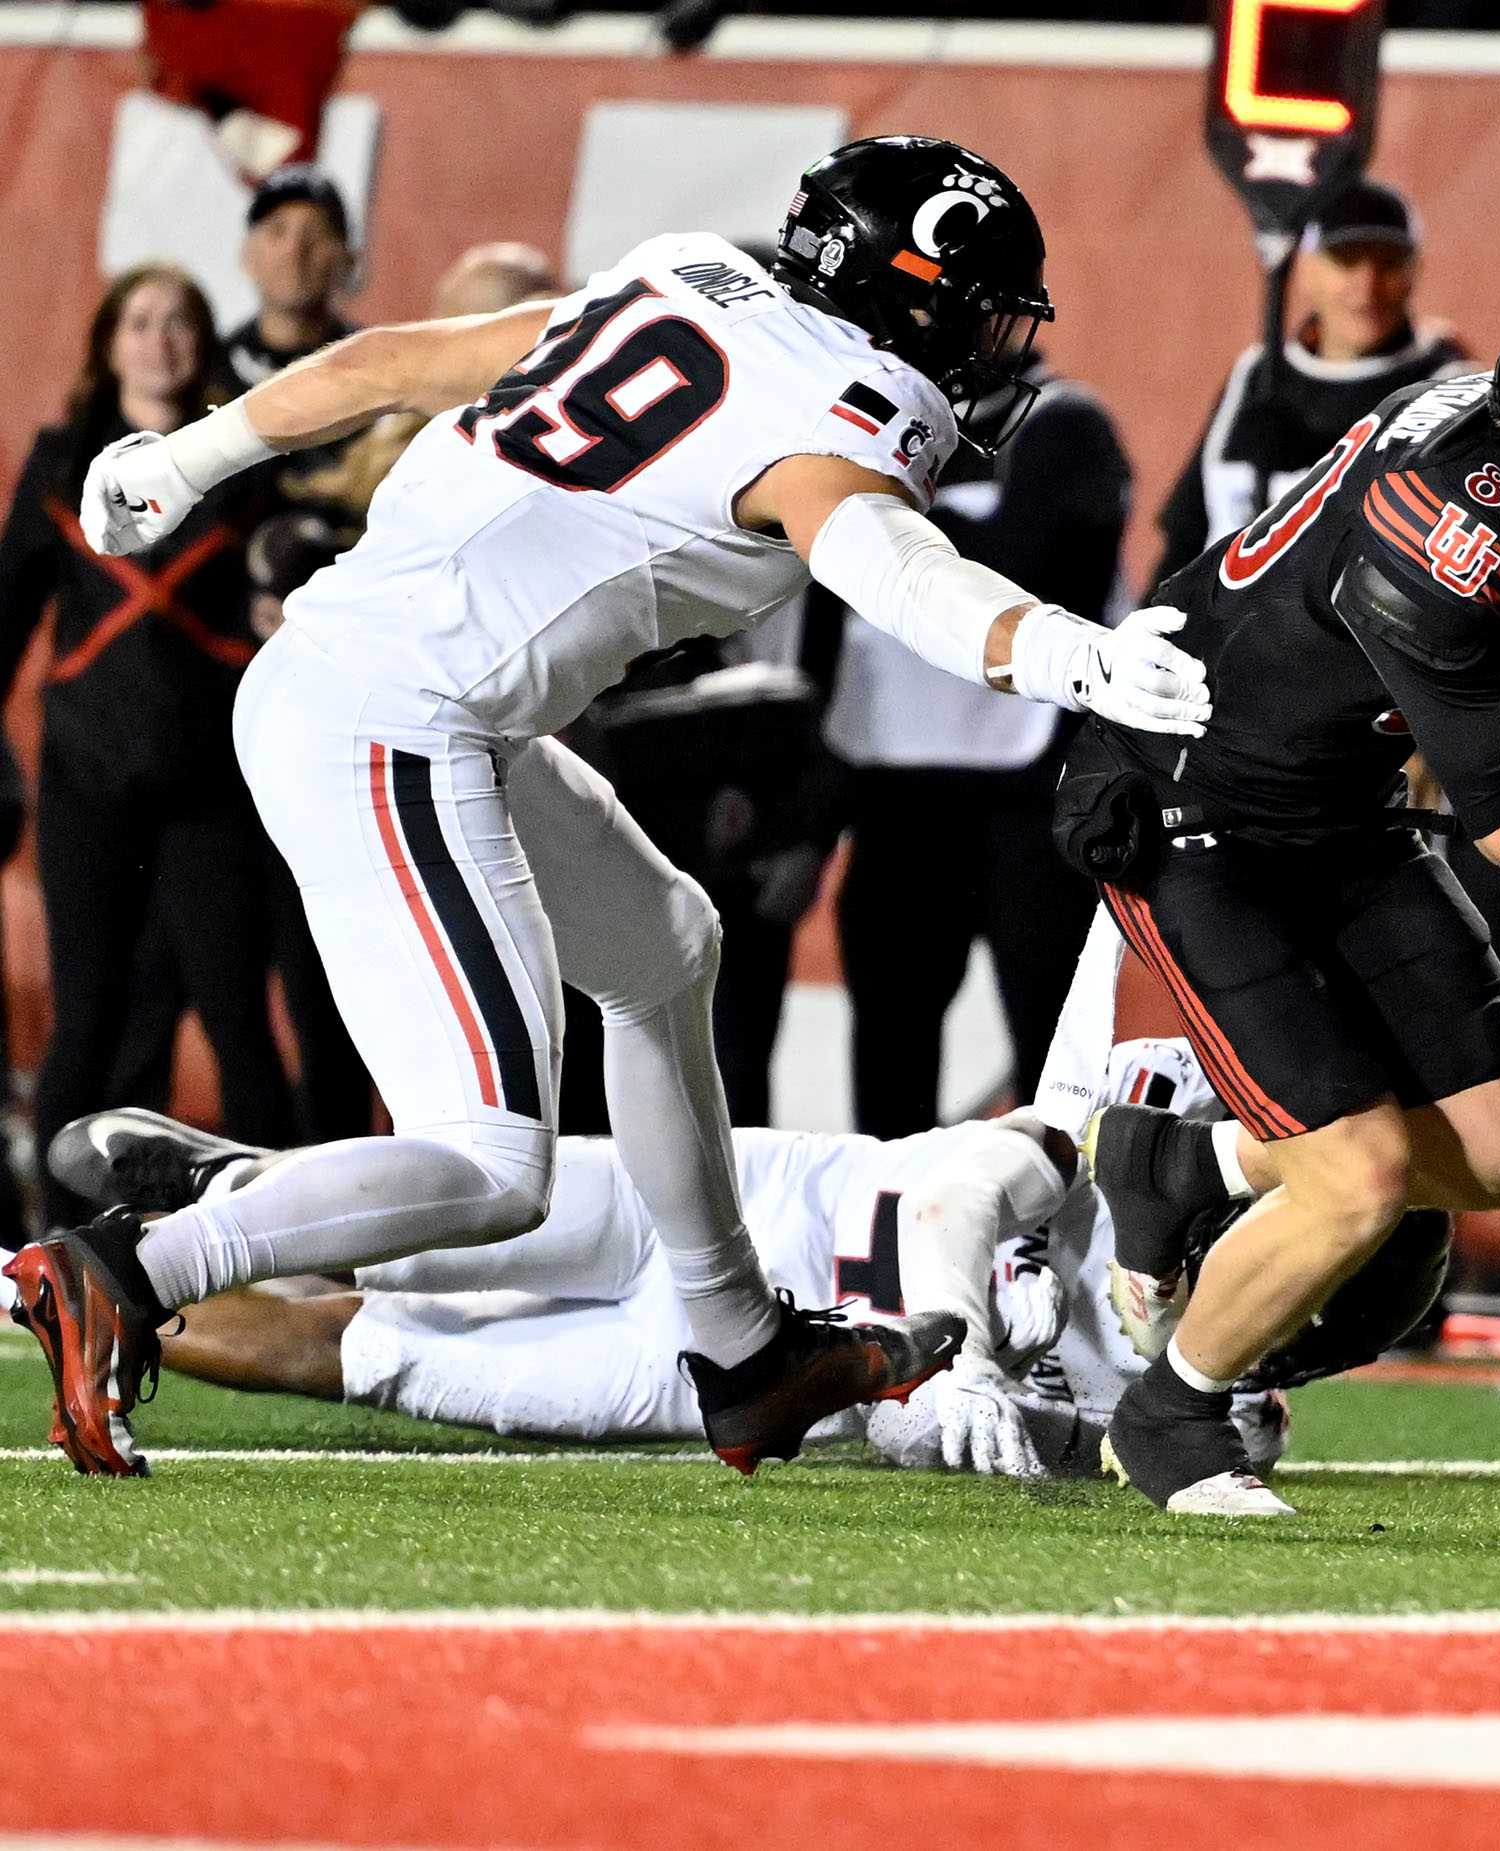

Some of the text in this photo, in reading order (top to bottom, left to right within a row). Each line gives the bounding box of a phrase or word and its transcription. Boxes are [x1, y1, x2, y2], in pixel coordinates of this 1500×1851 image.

[912, 190, 990, 258] C
[671, 262, 775, 309] DINGLE
[453, 276, 730, 495] 49
